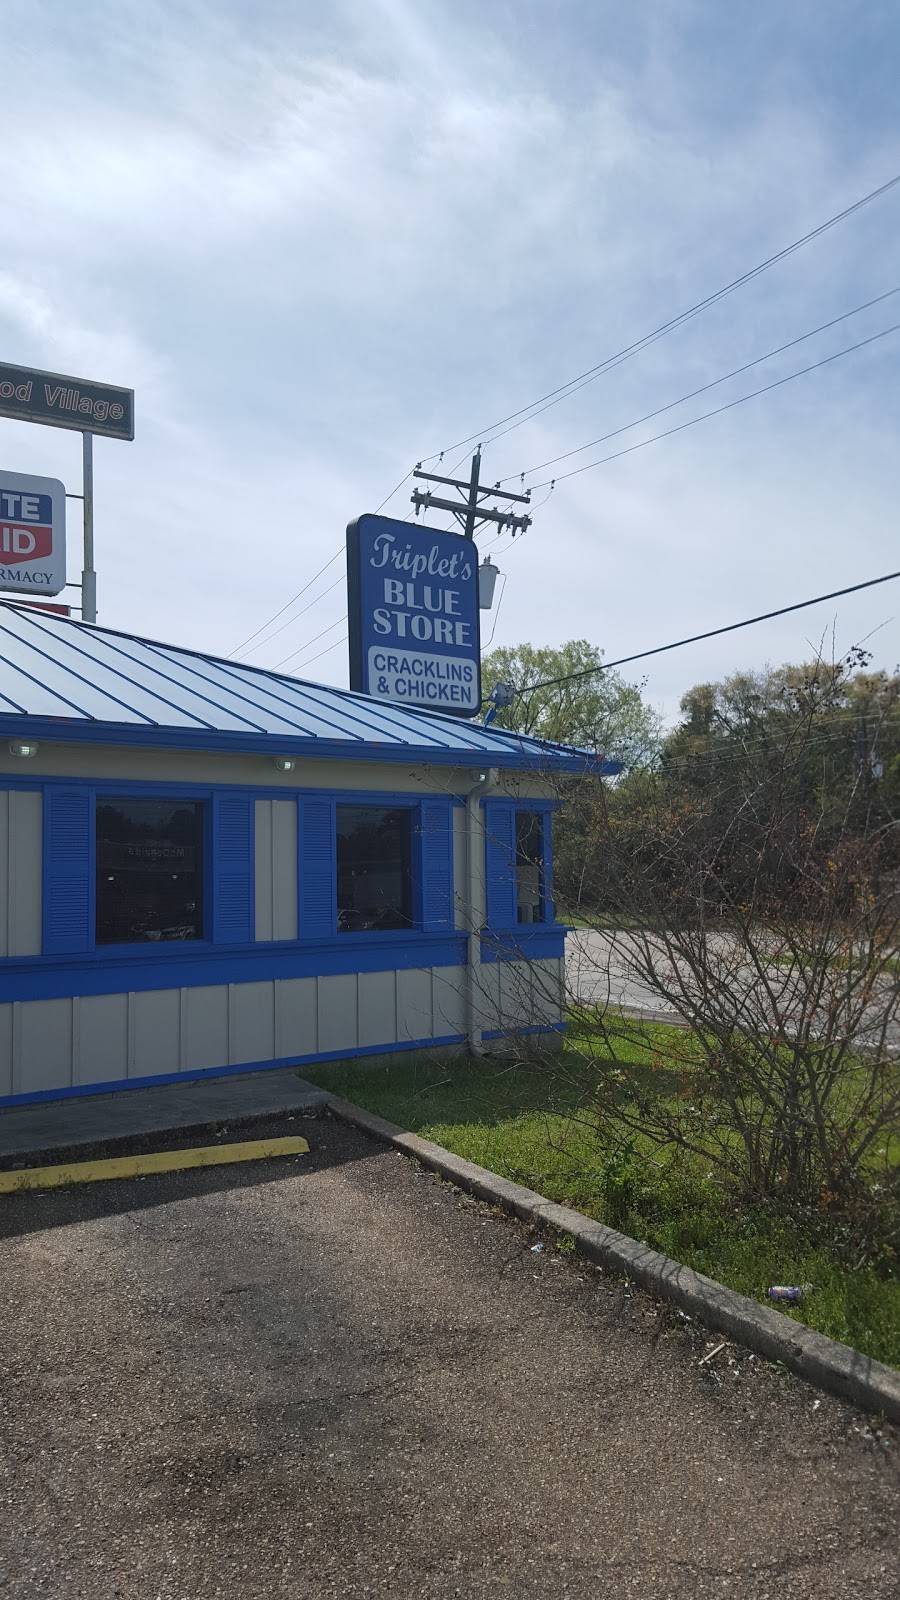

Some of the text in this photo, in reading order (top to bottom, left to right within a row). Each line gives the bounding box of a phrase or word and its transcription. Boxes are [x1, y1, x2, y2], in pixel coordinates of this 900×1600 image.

[44, 384, 124, 421] Village
[370, 533, 472, 581] Triplet's
[384, 578, 462, 616] BLUE
[373, 608, 473, 647] STORE
[373, 654, 473, 683] CRACKLINS
[377, 676, 471, 703] & CHICKEN
